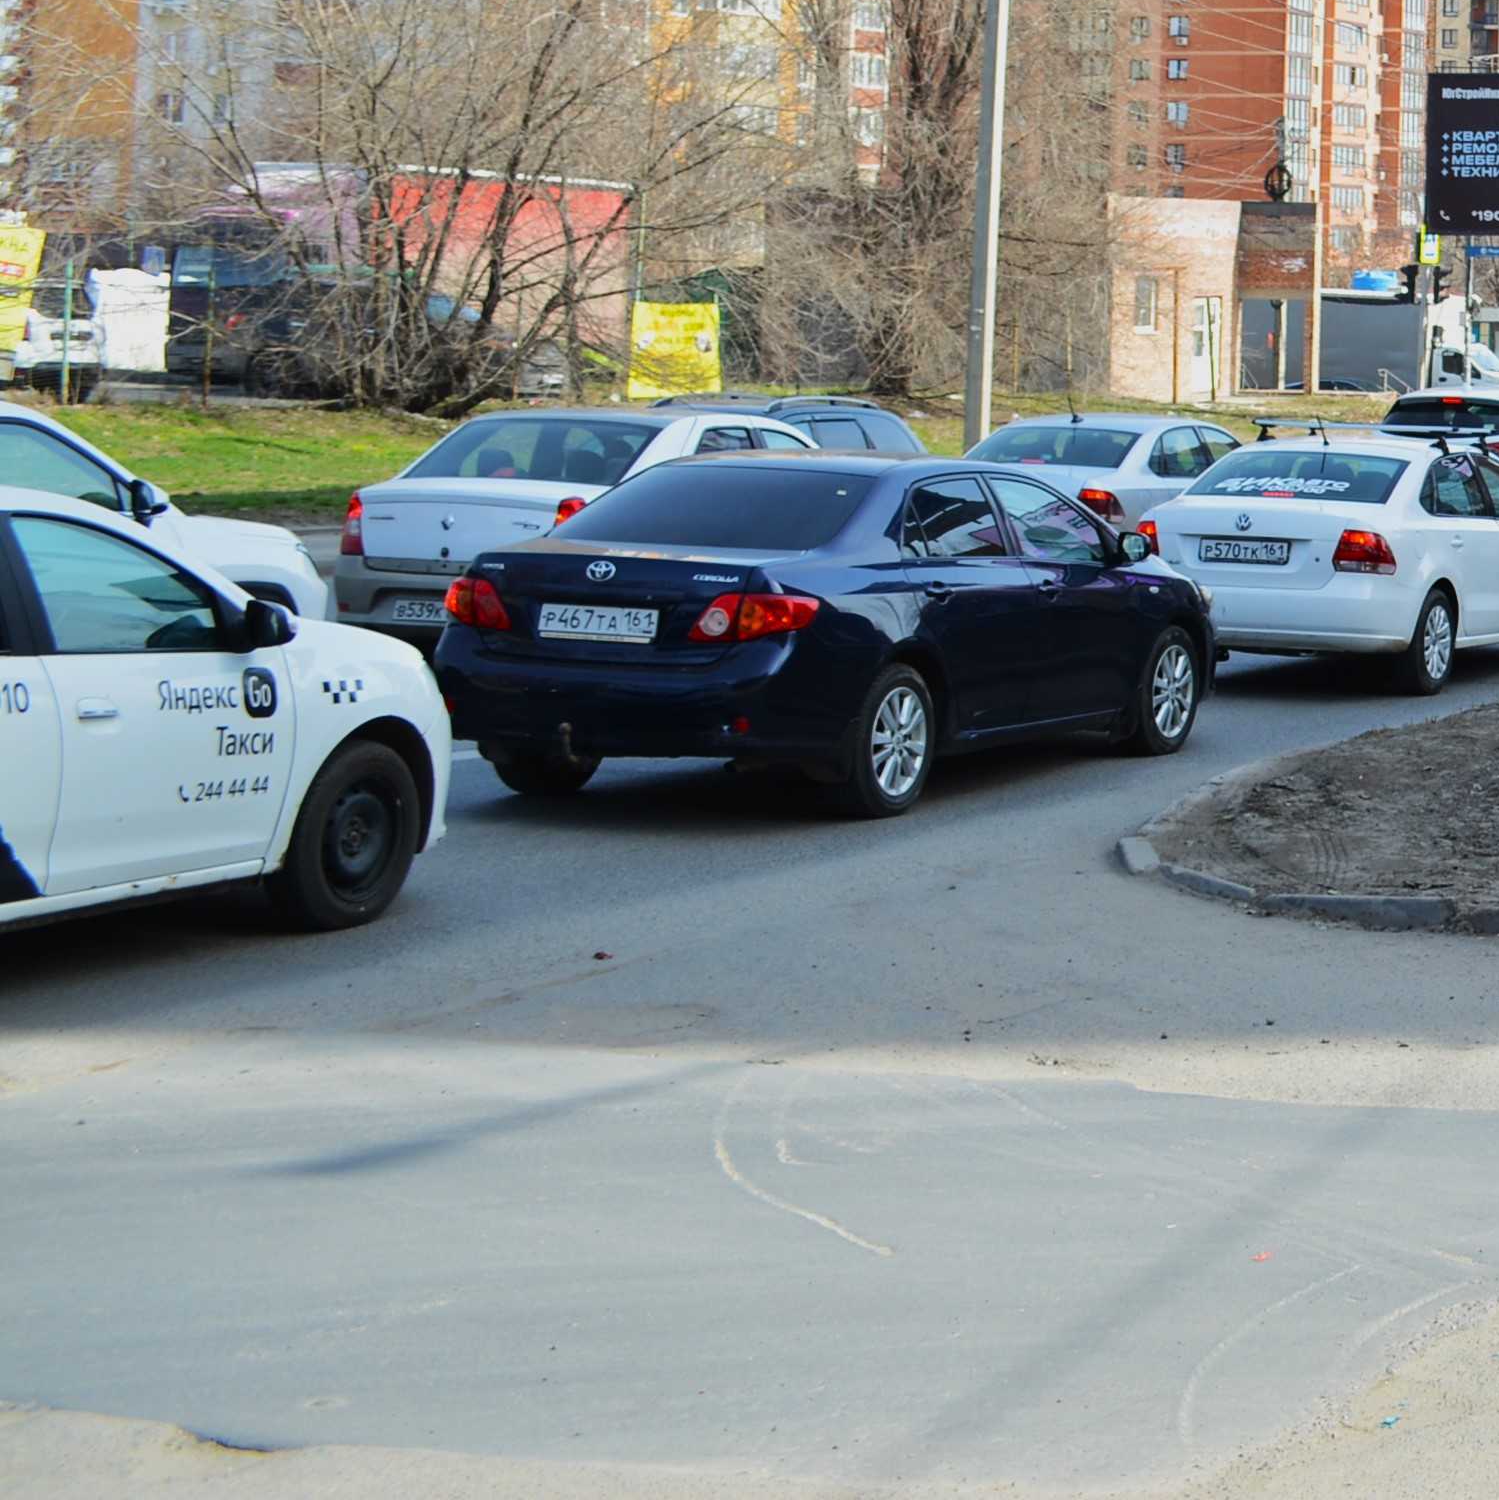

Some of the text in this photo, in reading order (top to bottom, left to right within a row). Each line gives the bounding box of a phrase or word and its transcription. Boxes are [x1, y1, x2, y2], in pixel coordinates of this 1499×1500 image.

[1204, 542, 1284, 559] Р570ТК 161
[396, 602, 444, 618] В539К
[545, 608, 654, 631] Р467ТА 161
[0, 682, 30, 714] 10
[158, 675, 273, 713] Яндекс Go
[215, 726, 275, 756] Такси
[194, 775, 270, 802] 244 44 44
